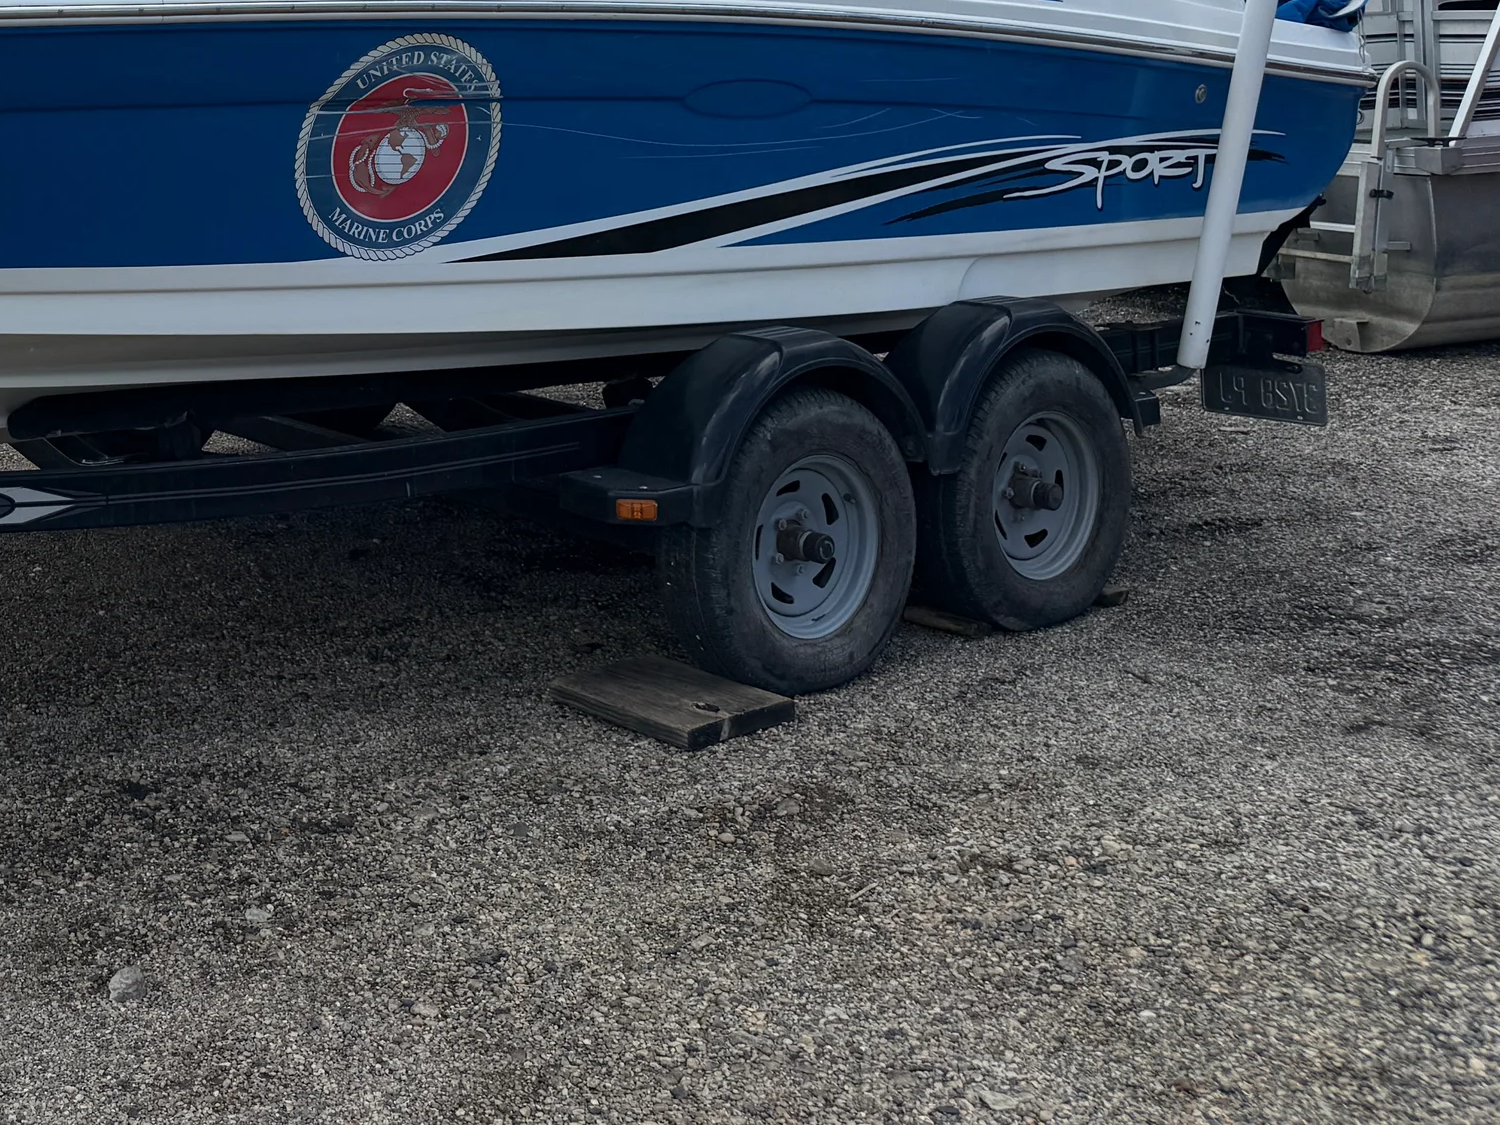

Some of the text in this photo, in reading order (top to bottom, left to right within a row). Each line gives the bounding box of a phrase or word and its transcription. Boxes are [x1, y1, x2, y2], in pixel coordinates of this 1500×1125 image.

[355, 50, 480, 92] UNITED STATES
[328, 207, 445, 243] MARINE CORPS
